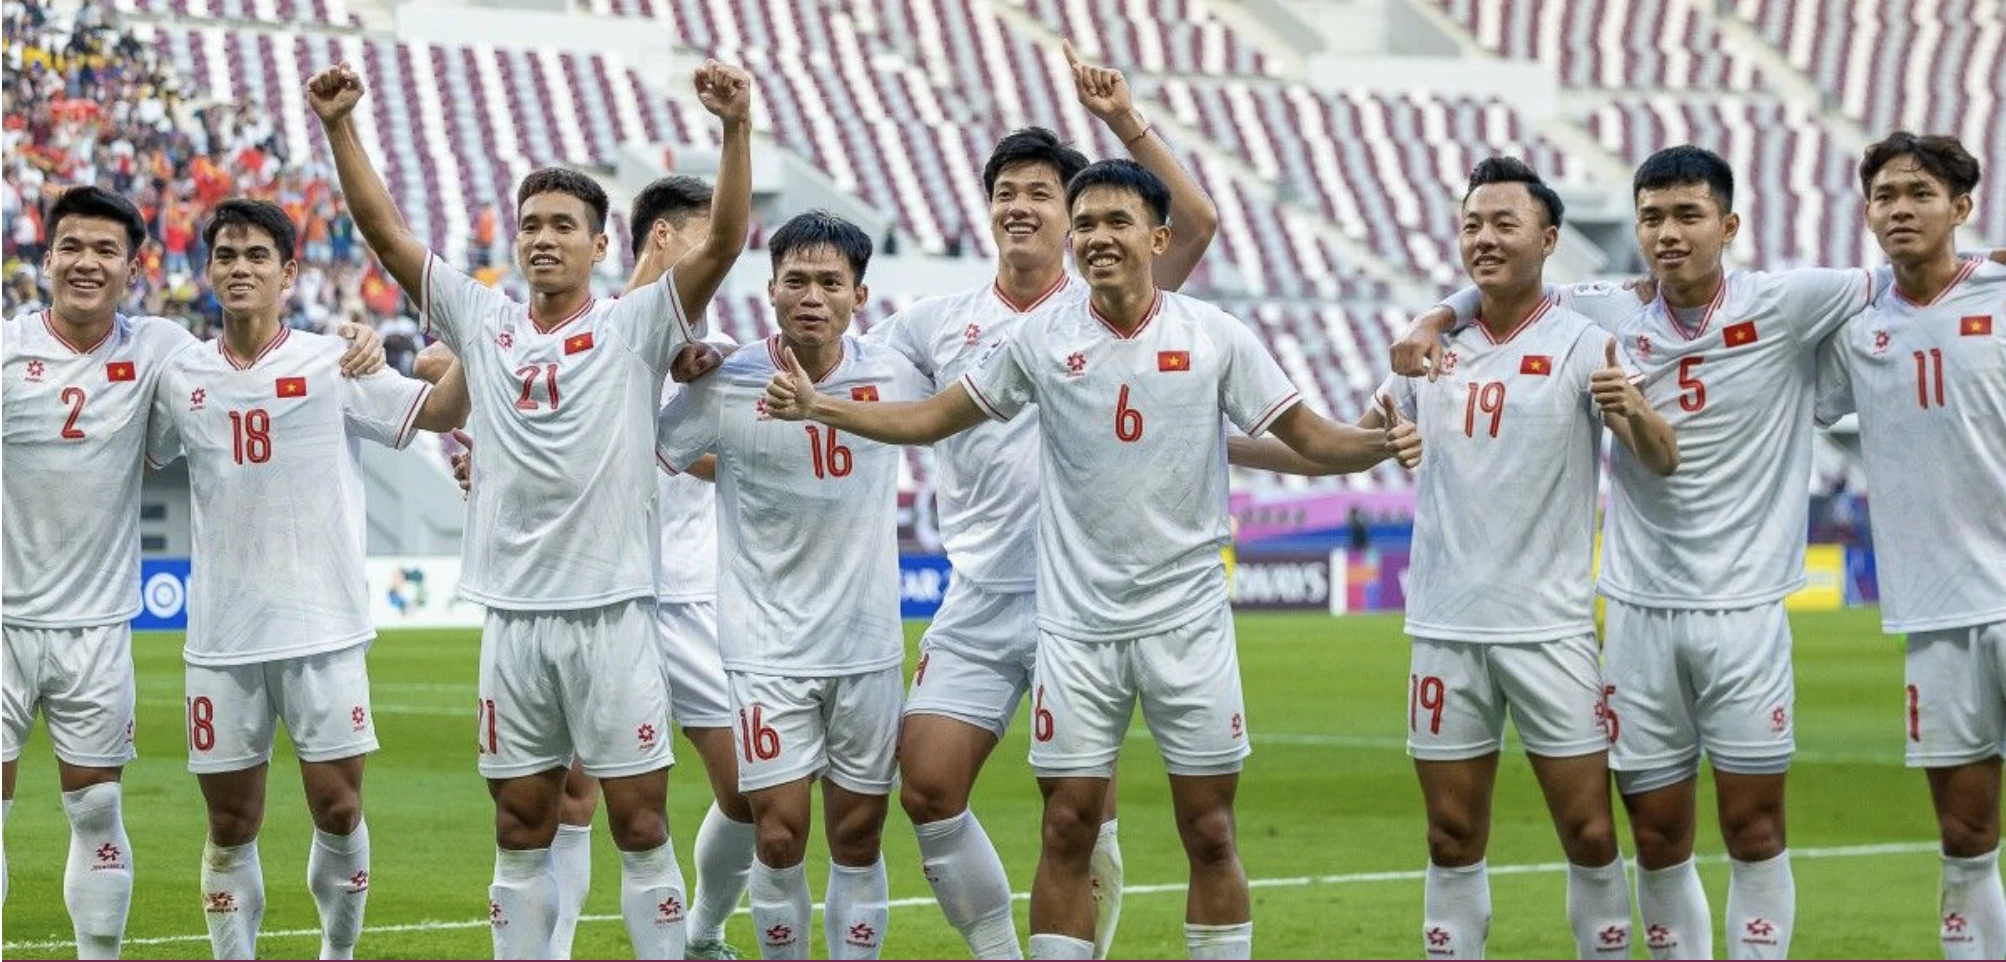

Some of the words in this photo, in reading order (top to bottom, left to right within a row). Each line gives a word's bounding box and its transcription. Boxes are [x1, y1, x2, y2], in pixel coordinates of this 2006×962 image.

[514, 363, 560, 411] 21
[1678, 356, 1707, 413] 5
[1913, 348, 1945, 410] 11
[60, 386, 86, 438] 2
[228, 408, 272, 466] 18
[1115, 383, 1144, 442] 6
[1464, 381, 1506, 438] 19
[805, 425, 853, 480] 16
[187, 696, 215, 753] 18
[1035, 684, 1054, 742] 6
[1411, 674, 1445, 735] 19
[739, 705, 780, 764] 16
